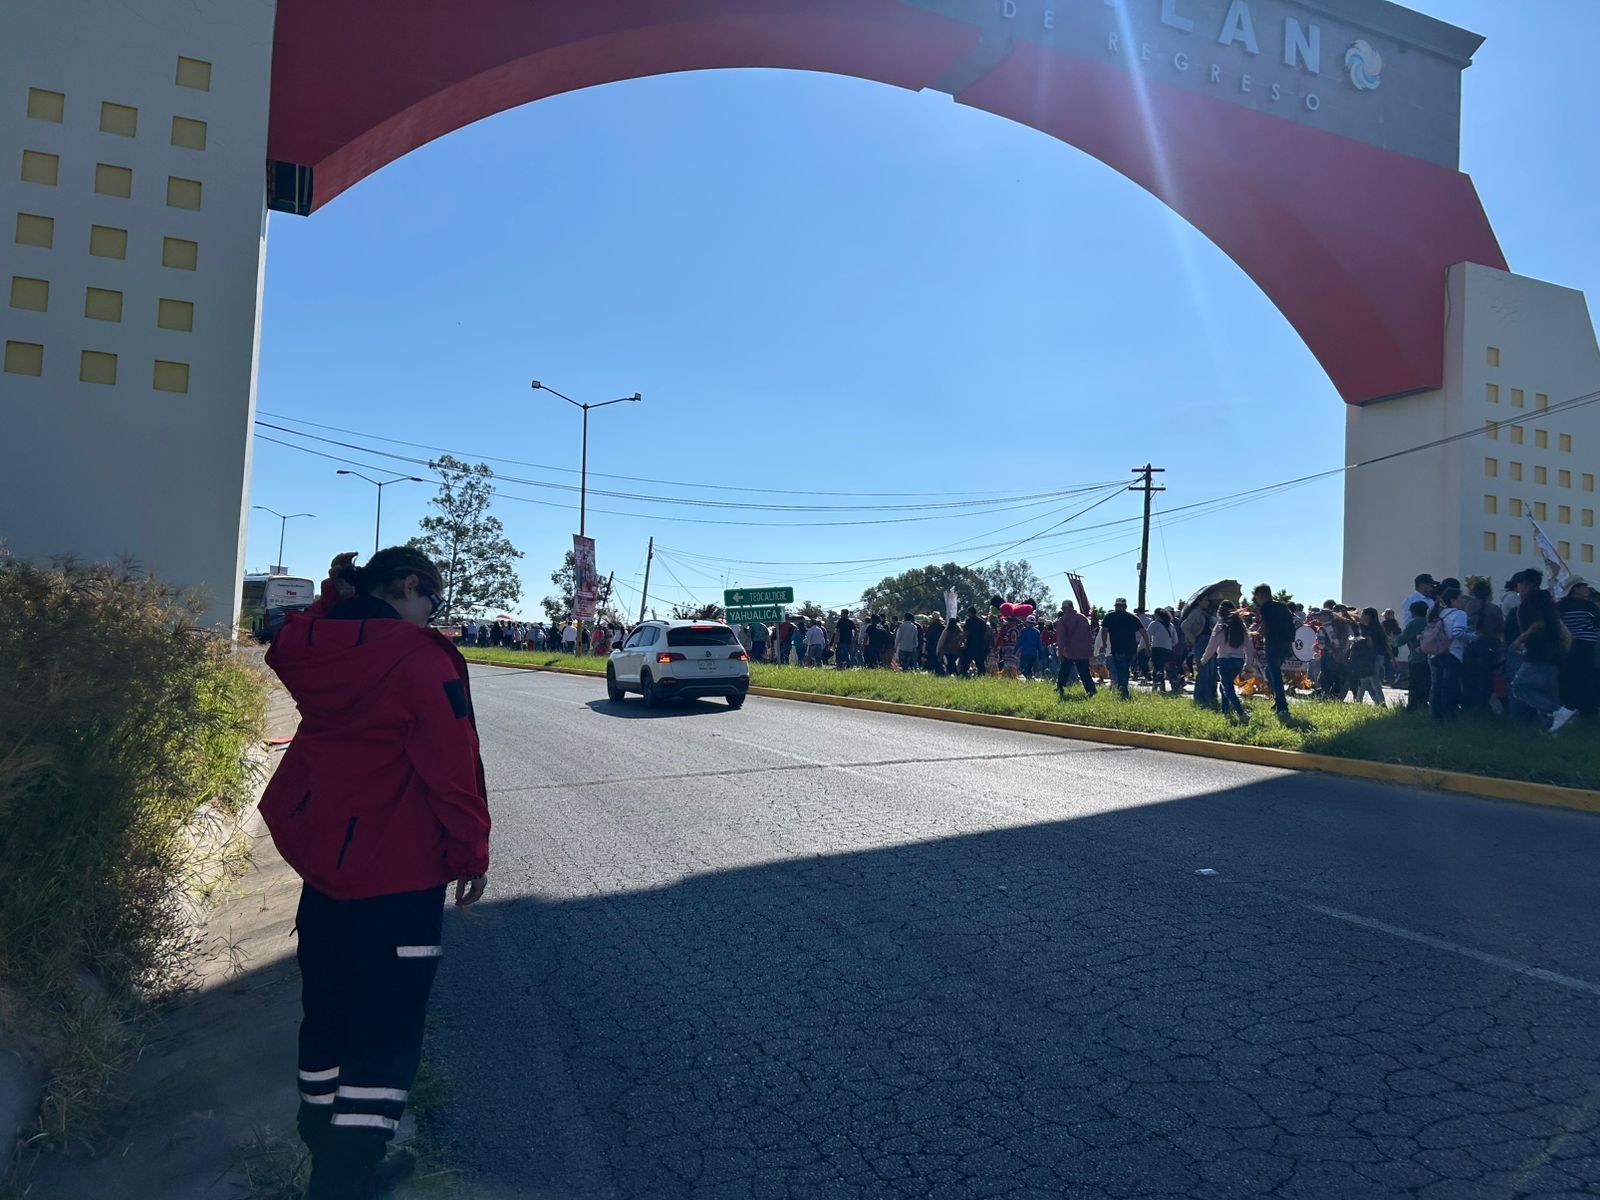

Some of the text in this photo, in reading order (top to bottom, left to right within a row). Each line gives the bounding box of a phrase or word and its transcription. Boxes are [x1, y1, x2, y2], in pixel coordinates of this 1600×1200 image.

[1002, 0, 1320, 111] DE REGRESO
[1105, 0, 1321, 75] LAN
[729, 609, 778, 621] YAHUALICA
[749, 591, 787, 602] TEOCALTICHE
